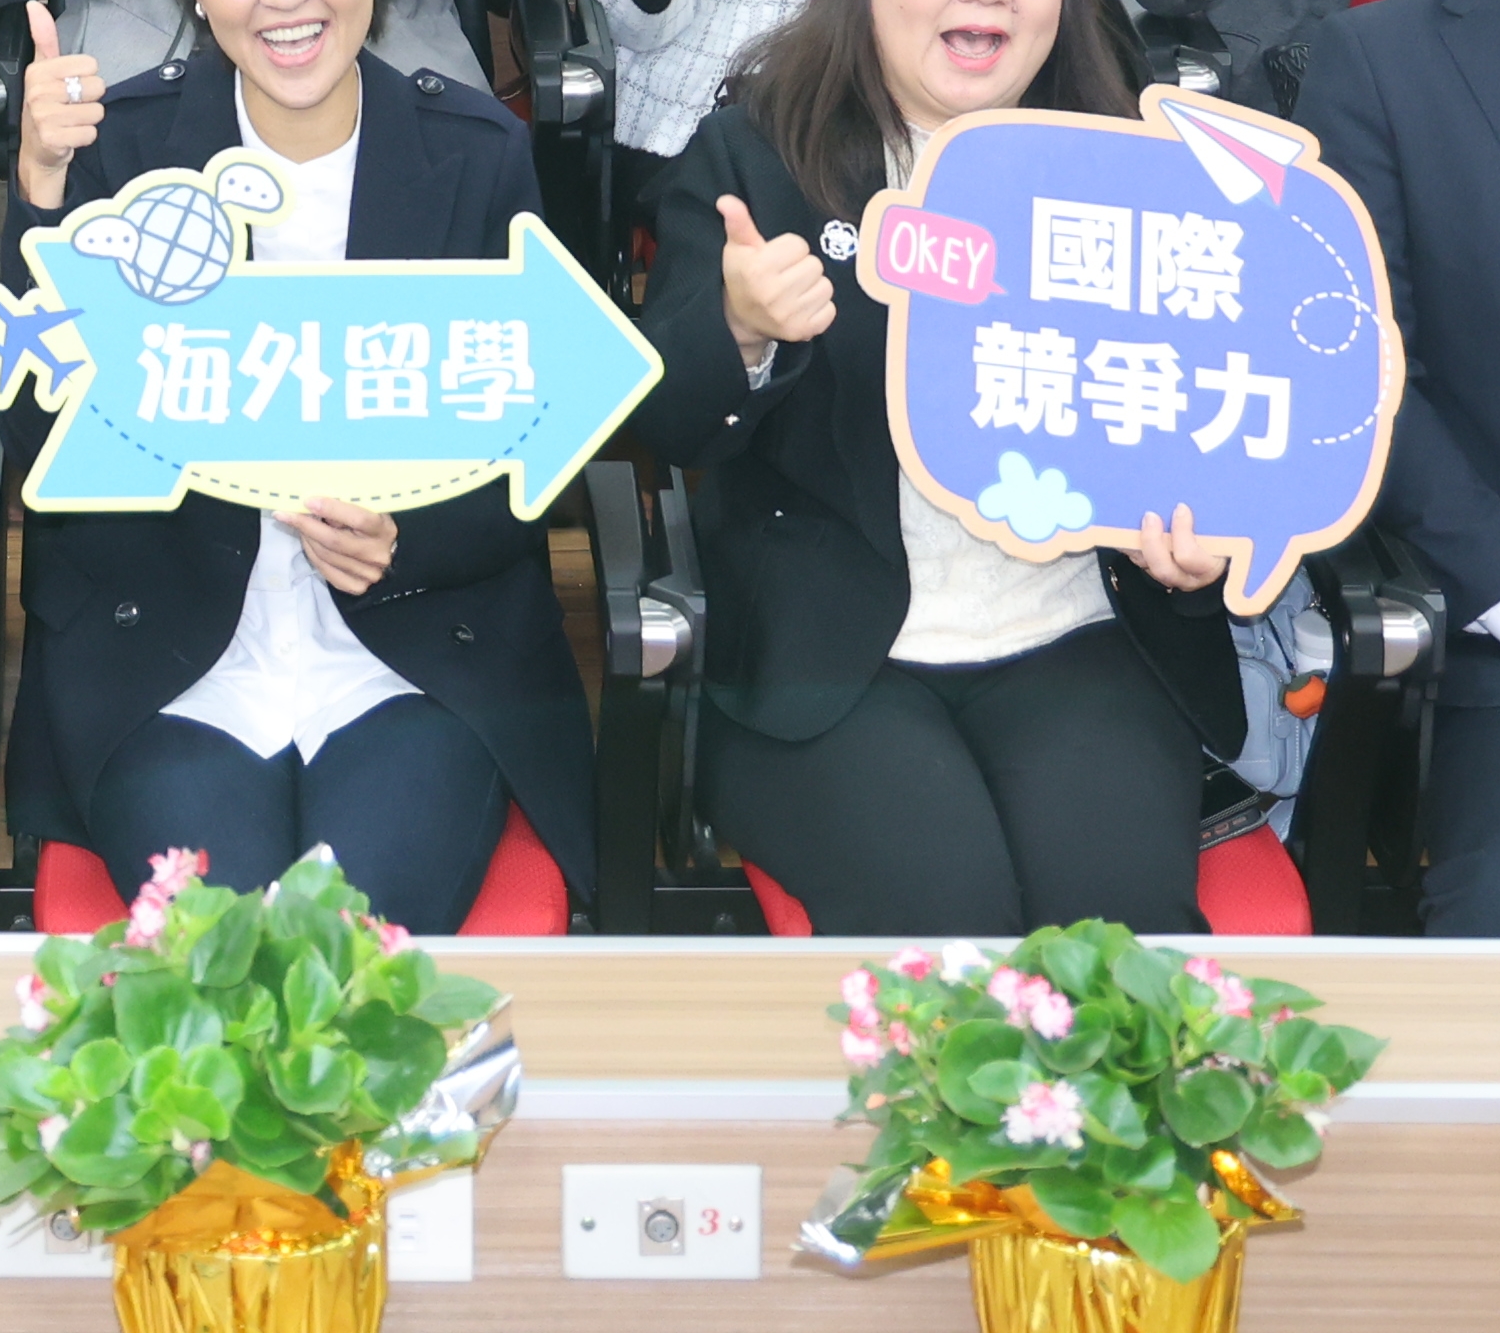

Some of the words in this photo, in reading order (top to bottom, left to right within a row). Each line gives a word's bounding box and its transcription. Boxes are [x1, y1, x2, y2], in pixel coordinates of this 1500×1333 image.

[887, 221, 989, 289] OKEY
[1031, 196, 1244, 323] 國際
[137, 320, 535, 425] 海外留學
[971, 323, 1290, 459] 競爭力
[699, 1208, 720, 1236] 3
